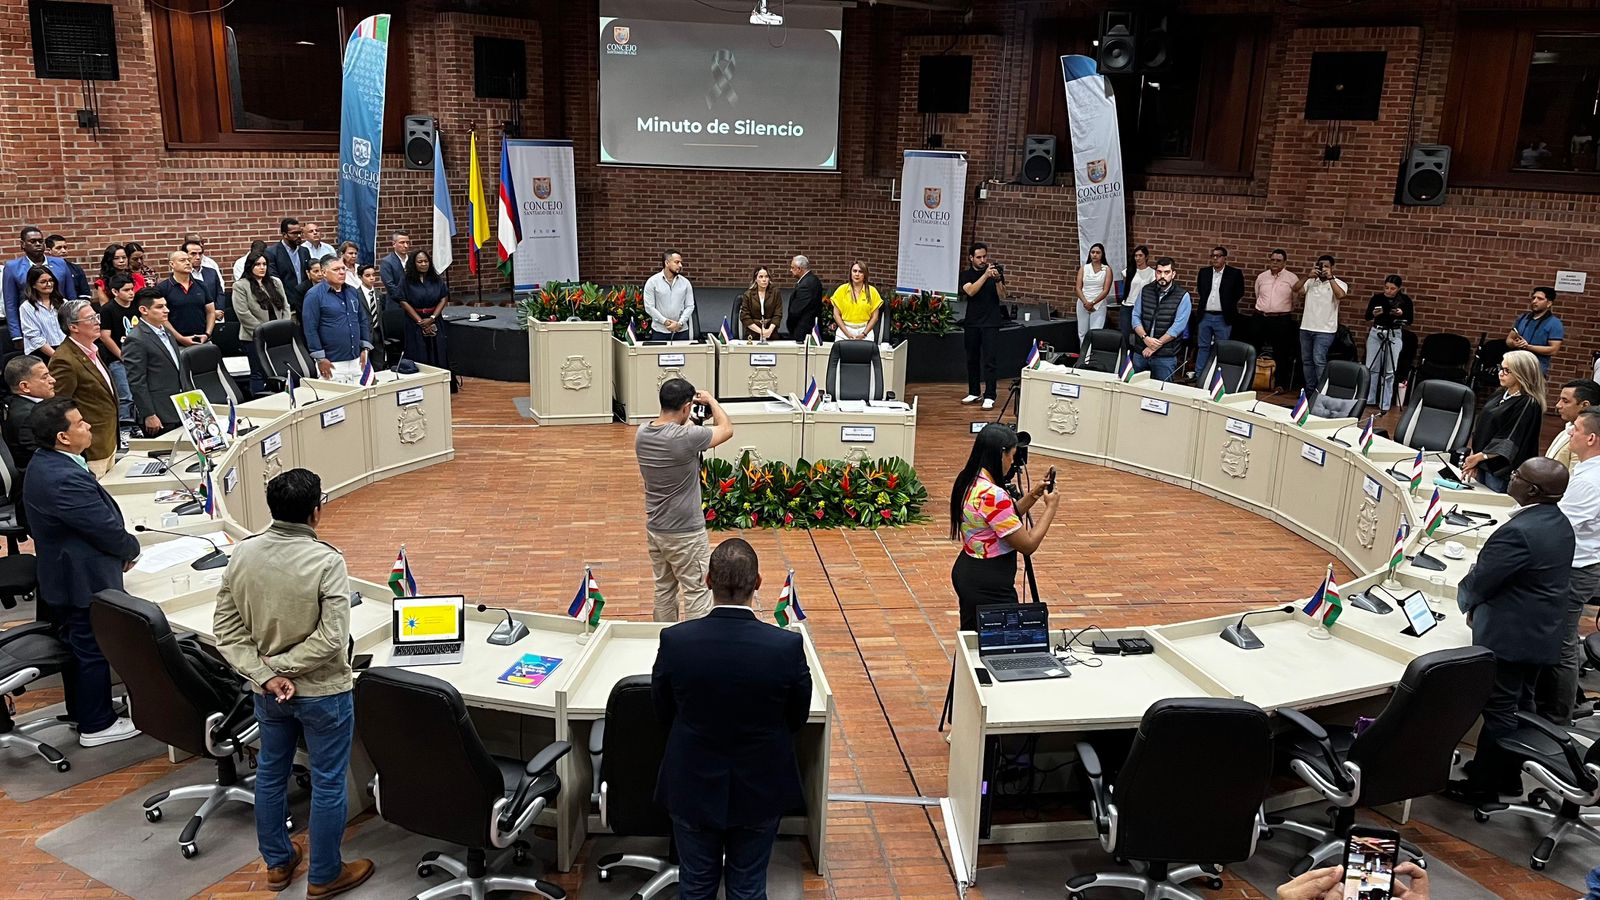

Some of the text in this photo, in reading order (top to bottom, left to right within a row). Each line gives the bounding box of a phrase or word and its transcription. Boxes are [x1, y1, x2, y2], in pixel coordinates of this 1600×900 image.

[606, 43, 637, 52] CONCEJO
[637, 116, 804, 137] Minuto de Silencio
[342, 162, 379, 184] CONCEJO
[1077, 181, 1121, 199] CONCEJO
[523, 200, 563, 211] CONCEJO
[912, 209, 951, 221] CONCEJO
